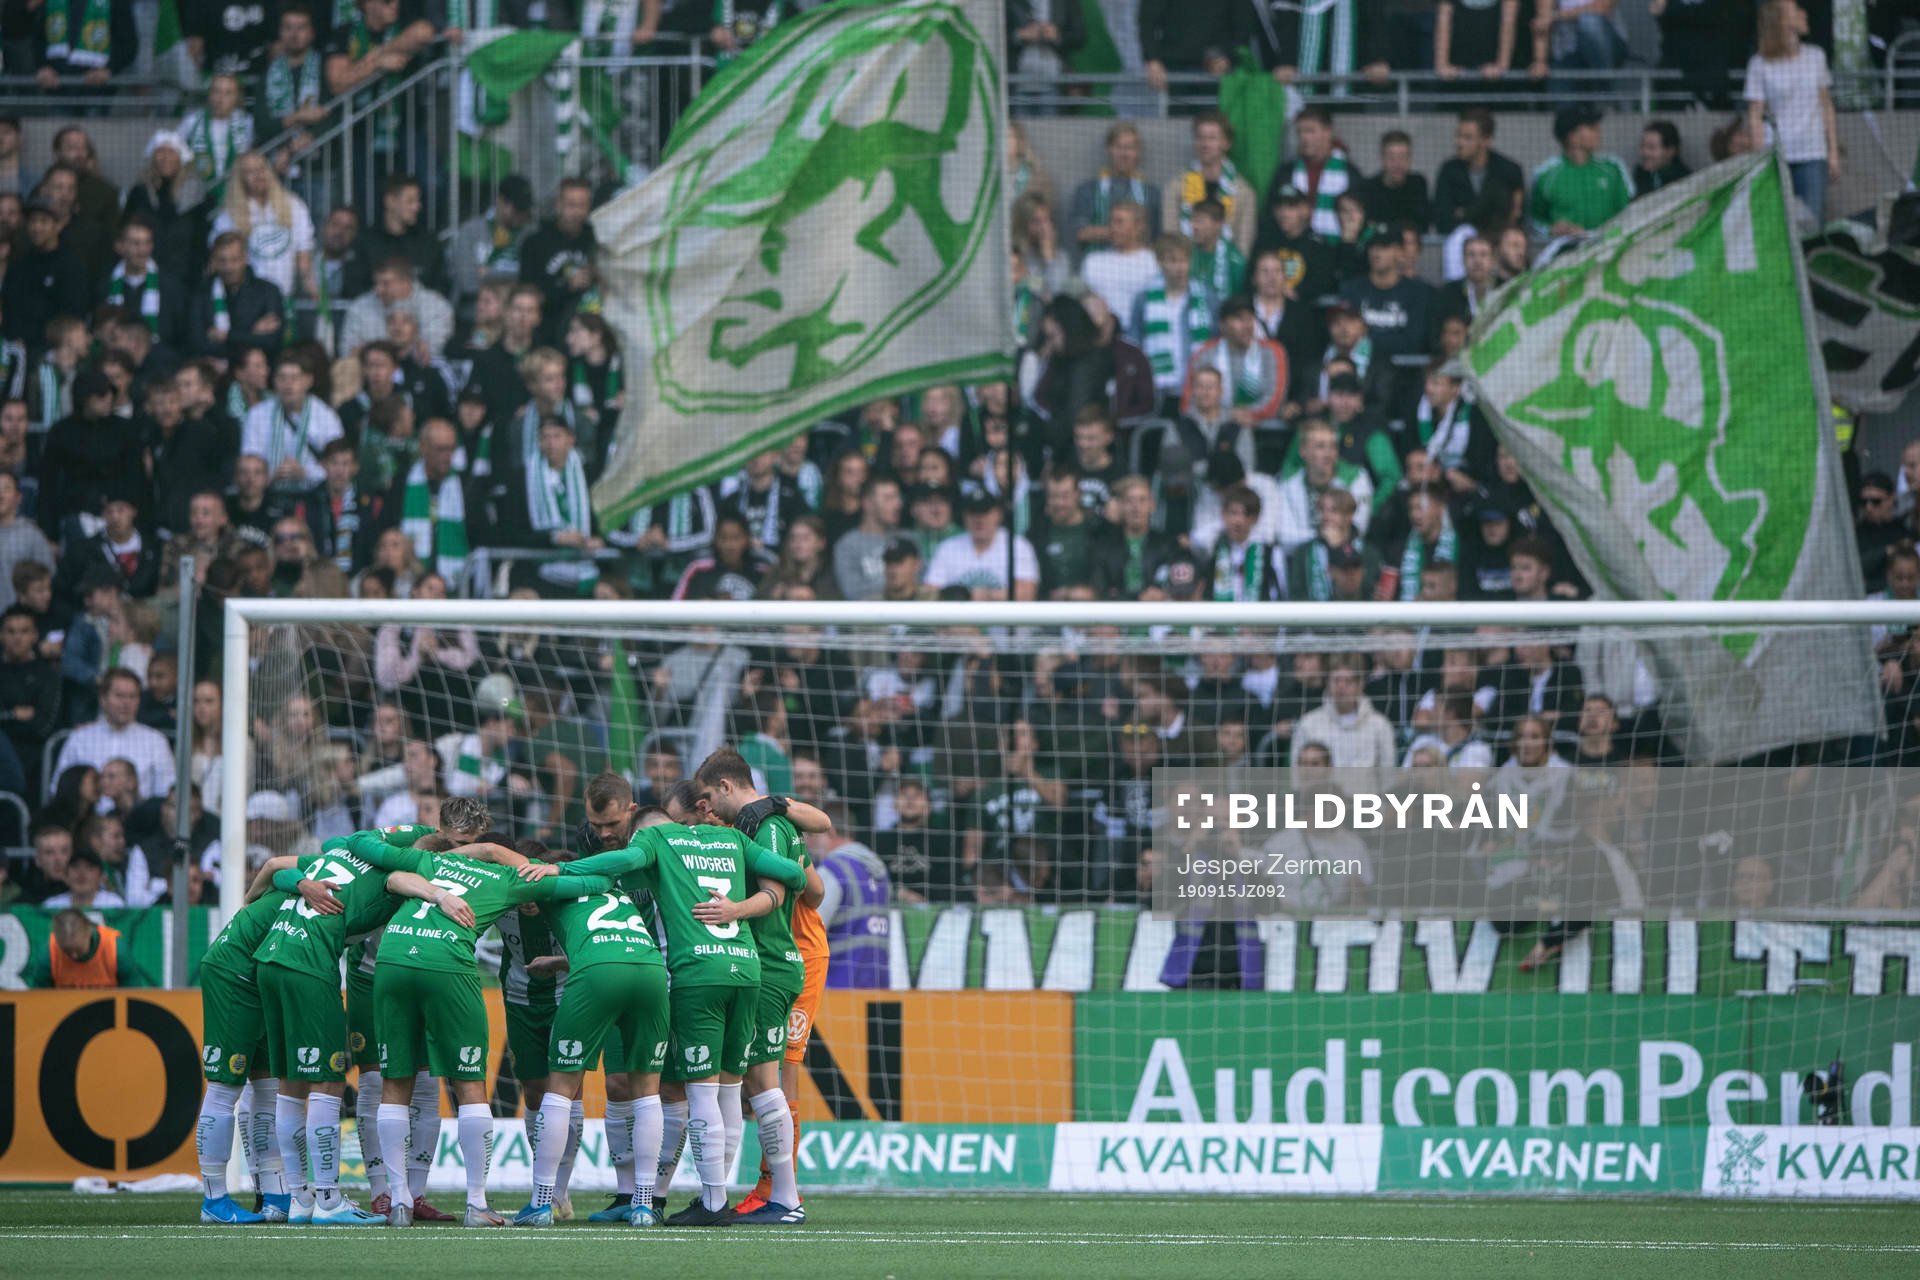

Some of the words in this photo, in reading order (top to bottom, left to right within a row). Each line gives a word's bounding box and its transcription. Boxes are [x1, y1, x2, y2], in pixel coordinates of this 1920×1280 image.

[682, 855, 736, 872] WIDGREN
[387, 924, 413, 935] SILJA
[416, 927, 442, 939] LINE
[592, 934, 624, 944] SILJA
[694, 944, 726, 955] SILJA
[727, 946, 750, 958] LINE
[315, 1126, 338, 1171] Clinton
[688, 1118, 708, 1162] Clinton
[1098, 1136, 1336, 1174] KVARNEN
[1420, 1138, 1662, 1182] KVARNEN
[1777, 1142, 1920, 1181] KVAR
